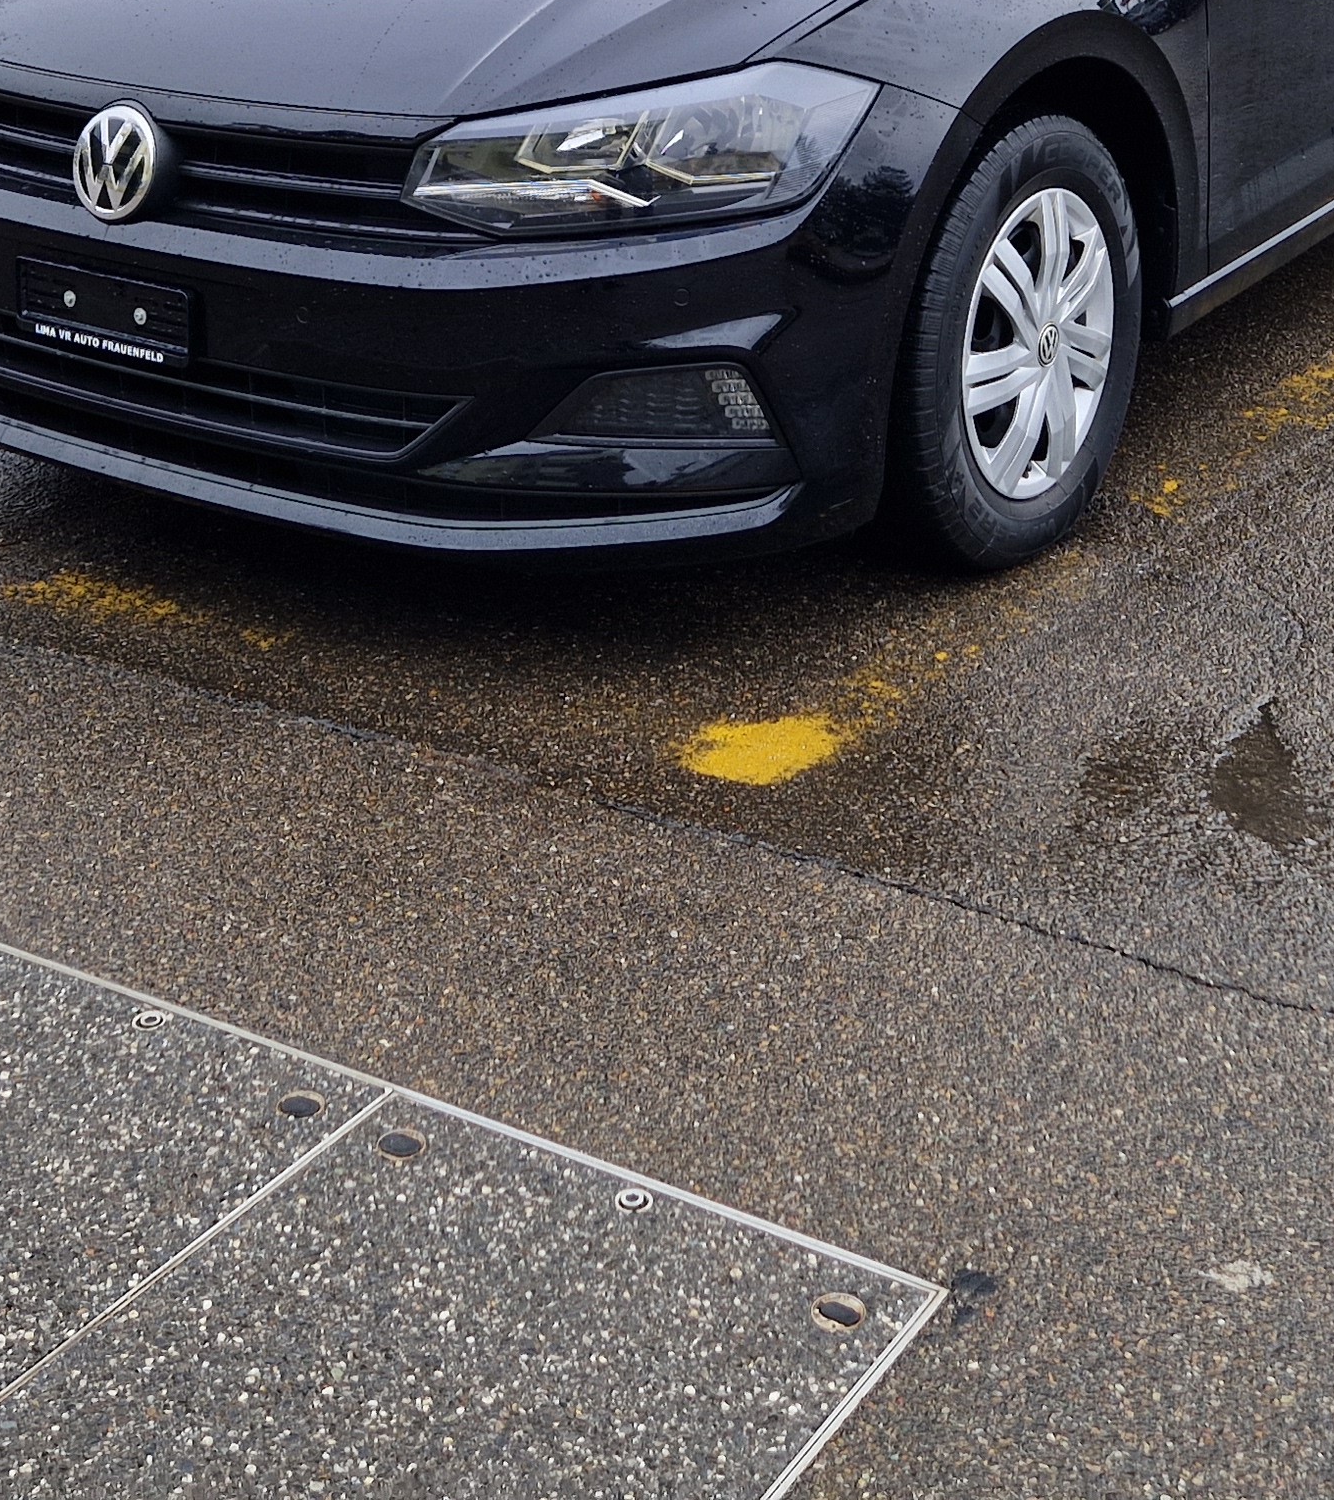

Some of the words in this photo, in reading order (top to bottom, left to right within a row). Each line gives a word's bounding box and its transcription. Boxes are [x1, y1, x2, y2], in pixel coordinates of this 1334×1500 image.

[59, 329, 71, 341] VR
[73, 333, 100, 348] AUTO
[102, 339, 164, 363] FRAUENFELD
